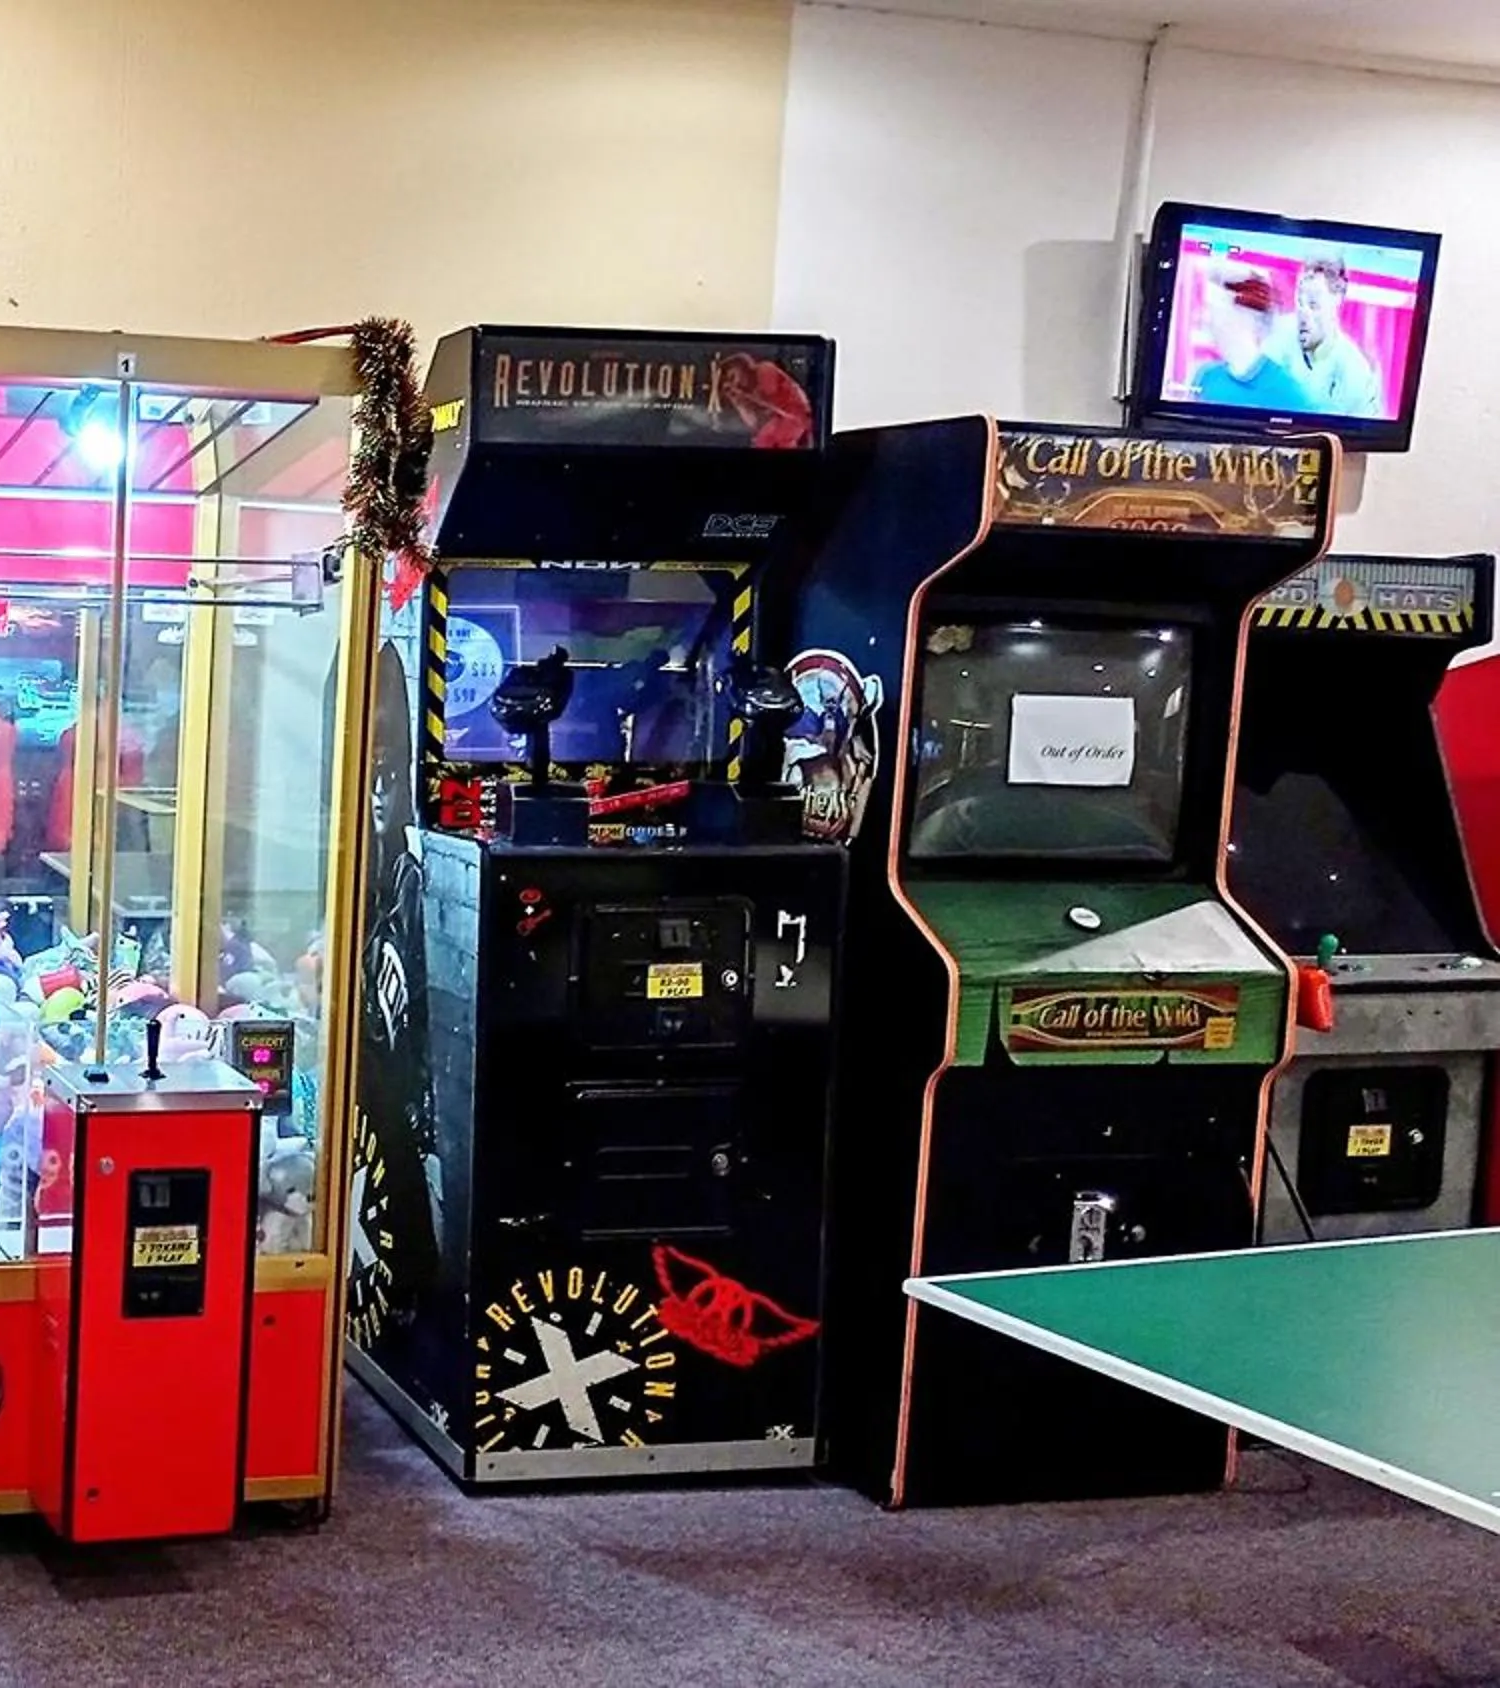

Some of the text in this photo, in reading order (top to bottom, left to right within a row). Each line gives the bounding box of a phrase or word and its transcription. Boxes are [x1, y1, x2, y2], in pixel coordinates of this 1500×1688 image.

[121, 358, 130, 373] 1
[1378, 590, 1458, 611] HATS
[1041, 745, 1126, 764] Out of Order
[1039, 1003, 1201, 1029] Call of the Wild
